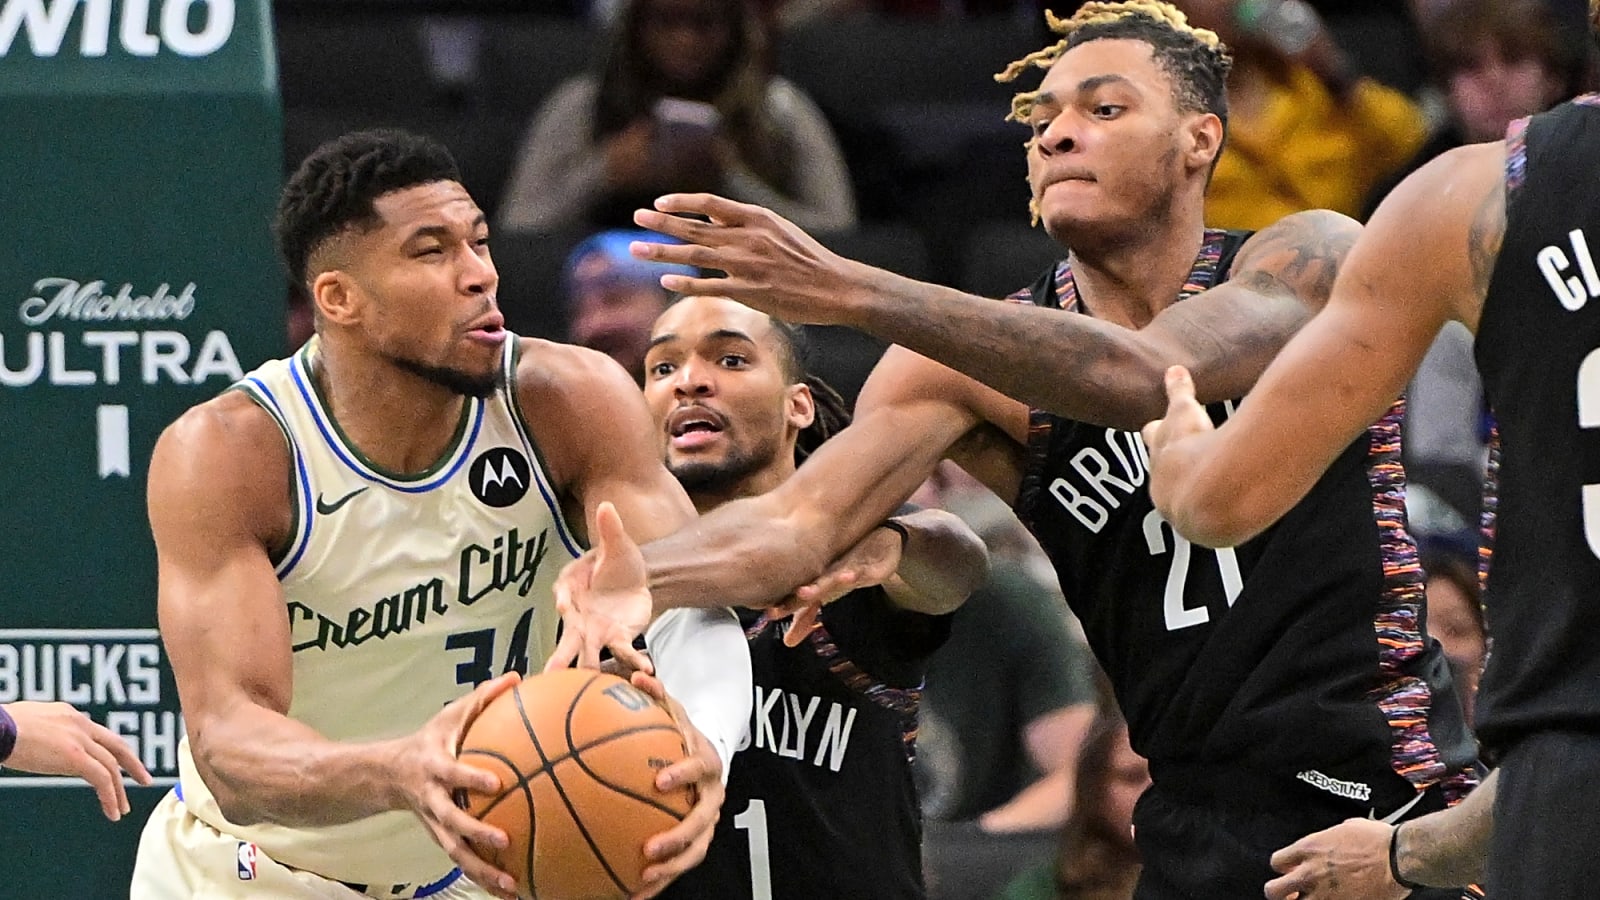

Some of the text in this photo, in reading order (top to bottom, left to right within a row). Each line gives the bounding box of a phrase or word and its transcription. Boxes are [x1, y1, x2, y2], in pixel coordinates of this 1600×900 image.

[19, 277, 197, 326] Michelob
[0, 330, 244, 387] ULTRA
[287, 527, 549, 653] Cream City
[0, 643, 161, 705] BUCKS
[734, 798, 773, 900] 1
